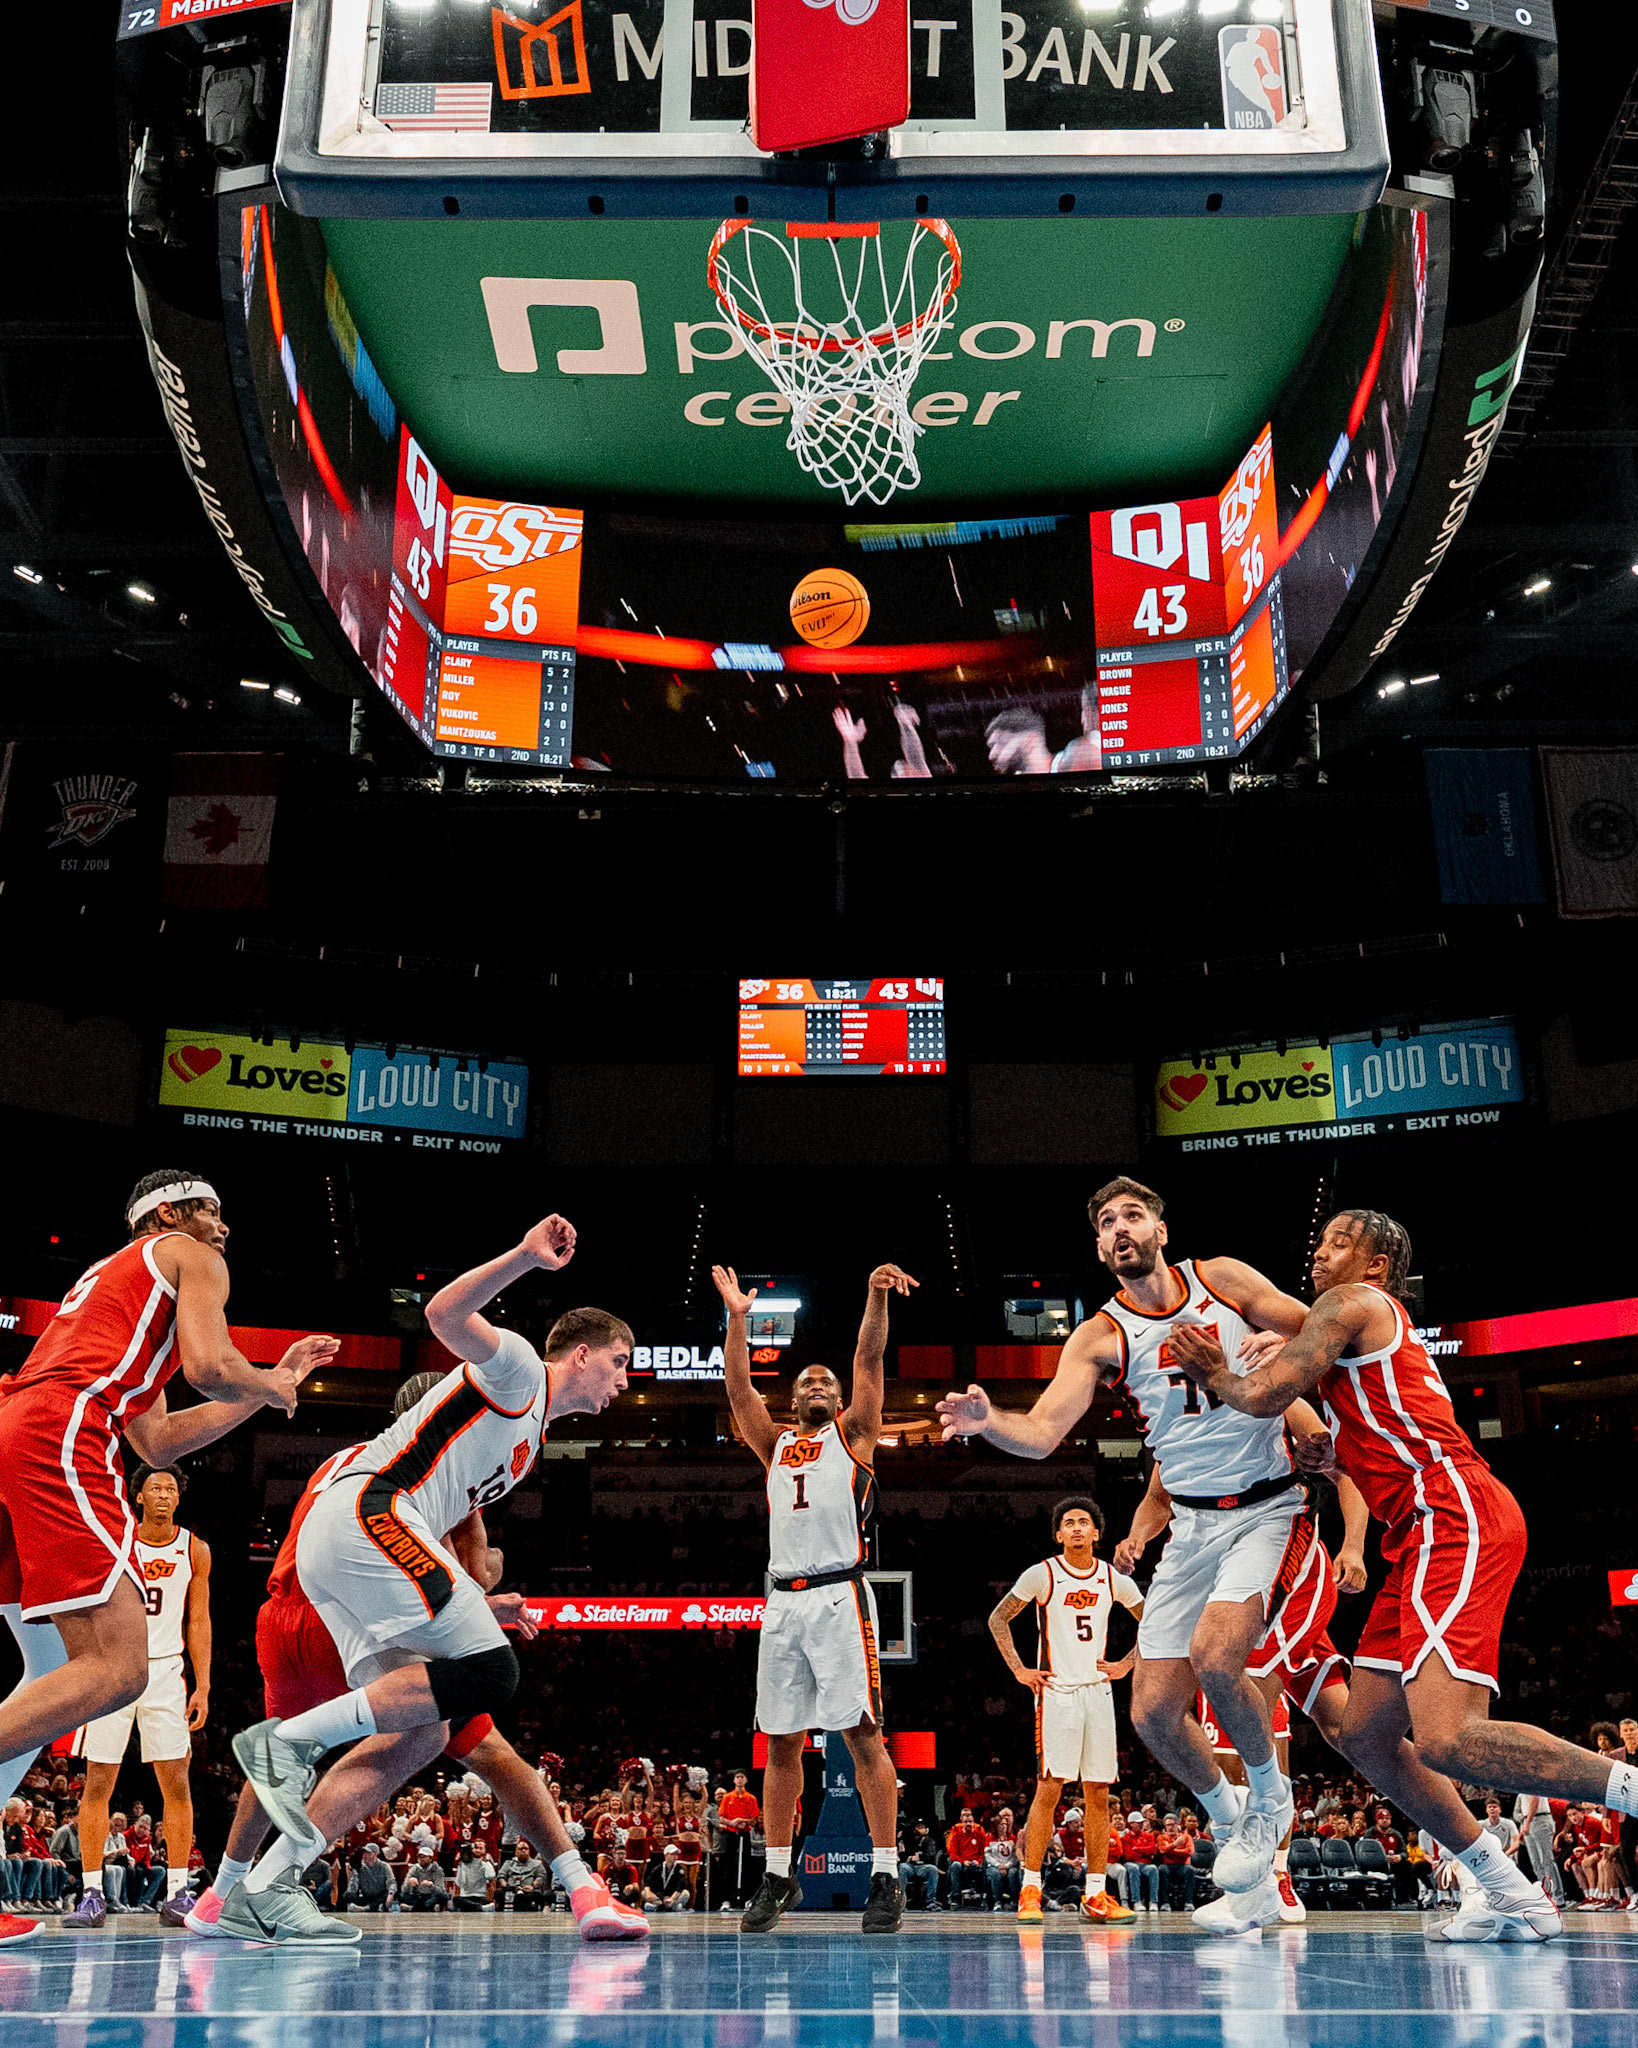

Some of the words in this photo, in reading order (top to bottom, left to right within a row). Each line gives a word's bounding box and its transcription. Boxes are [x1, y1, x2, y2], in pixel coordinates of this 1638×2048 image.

[128, 8, 155, 30] 72
[1233, 110, 1265, 129] NBA
[407, 536, 433, 600] 43
[1240, 534, 1265, 606] 36
[484, 583, 538, 635] 36
[1133, 584, 1188, 637] 43
[446, 639, 480, 652] PLAYER
[542, 650, 559, 660] PTS
[562, 652, 573, 661] FL
[1100, 651, 1133, 664] PLAYER
[1195, 643, 1213, 654] PTS
[1214, 640, 1227, 651] FL
[444, 656, 473, 669] CLARY
[547, 667, 554, 677] 5
[563, 669, 570, 678] 2
[1099, 668, 1132, 681] BROWN
[1202, 659, 1209, 670] 7
[1219, 657, 1225, 668] 1
[442, 673, 475, 686] MILLER
[546, 684, 553, 694] 7
[562, 686, 568, 695] 1
[1099, 685, 1132, 697] WAGUE
[1203, 676, 1210, 687] 4
[1220, 674, 1226, 685] 1
[441, 690, 461, 702] ROY
[543, 701, 555, 711] 13
[561, 702, 567, 712] 0
[1100, 702, 1129, 715] JONES
[1221, 692, 1227, 702] 1
[440, 707, 479, 721] VUKOVIC
[543, 719, 551, 729] 4
[560, 720, 567, 730] 0
[1101, 720, 1128, 732] DAVIS
[1205, 711, 1213, 722] 2
[1221, 709, 1228, 720] 0
[439, 725, 497, 741] MANTZOUKAS
[543, 736, 550, 746] 2
[1102, 737, 1125, 749] REID
[1206, 729, 1214, 739] 5
[1222, 727, 1230, 737] 0
[460, 745, 467, 755] 3
[511, 750, 530, 761] 2ND
[539, 753, 563, 765] 18:21
[1126, 754, 1133, 765] 3
[1139, 753, 1151, 764] TF
[1155, 752, 1161, 762] 1
[1176, 748, 1195, 760] 2ND
[1204, 745, 1229, 757] 18:21
[52, 774, 138, 806] THUNDER
[1497, 790, 1515, 857] OKLAHOMA
[60, 859, 82, 871] EST.
[83, 858, 110, 871] 2008
[776, 983, 805, 1001] 36
[825, 988, 858, 1000] 18:21
[878, 982, 909, 1000] 43
[1342, 1044, 1427, 1110] LOUD
[1438, 1042, 1513, 1092] CITY
[356, 1064, 441, 1113] LOUD
[453, 1070, 521, 1127] CITY
[183, 1113, 245, 1131] BRING
[250, 1118, 288, 1134] THE
[293, 1123, 384, 1144] THUNDER
[412, 1135, 454, 1151] EXIT
[459, 1139, 502, 1155] NOW
[1181, 1135, 1239, 1152] BRING
[1243, 1131, 1281, 1147] THE
[1285, 1122, 1376, 1143] THUNDER
[1405, 1115, 1450, 1132] EXIT
[1454, 1110, 1501, 1127] NOW
[633, 1346, 749, 1369] BEDLA
[778, 1438, 824, 1469] OSU
[792, 1473, 809, 1512] 1
[366, 1511, 436, 1578] COWBOYS
[1281, 1515, 1313, 1594] COWBOYS
[1064, 1589, 1099, 1610] OSU
[1075, 1614, 1094, 1642] 5
[865, 1619, 880, 1689] COWBOYS
[828, 1863, 857, 1874] BANK
